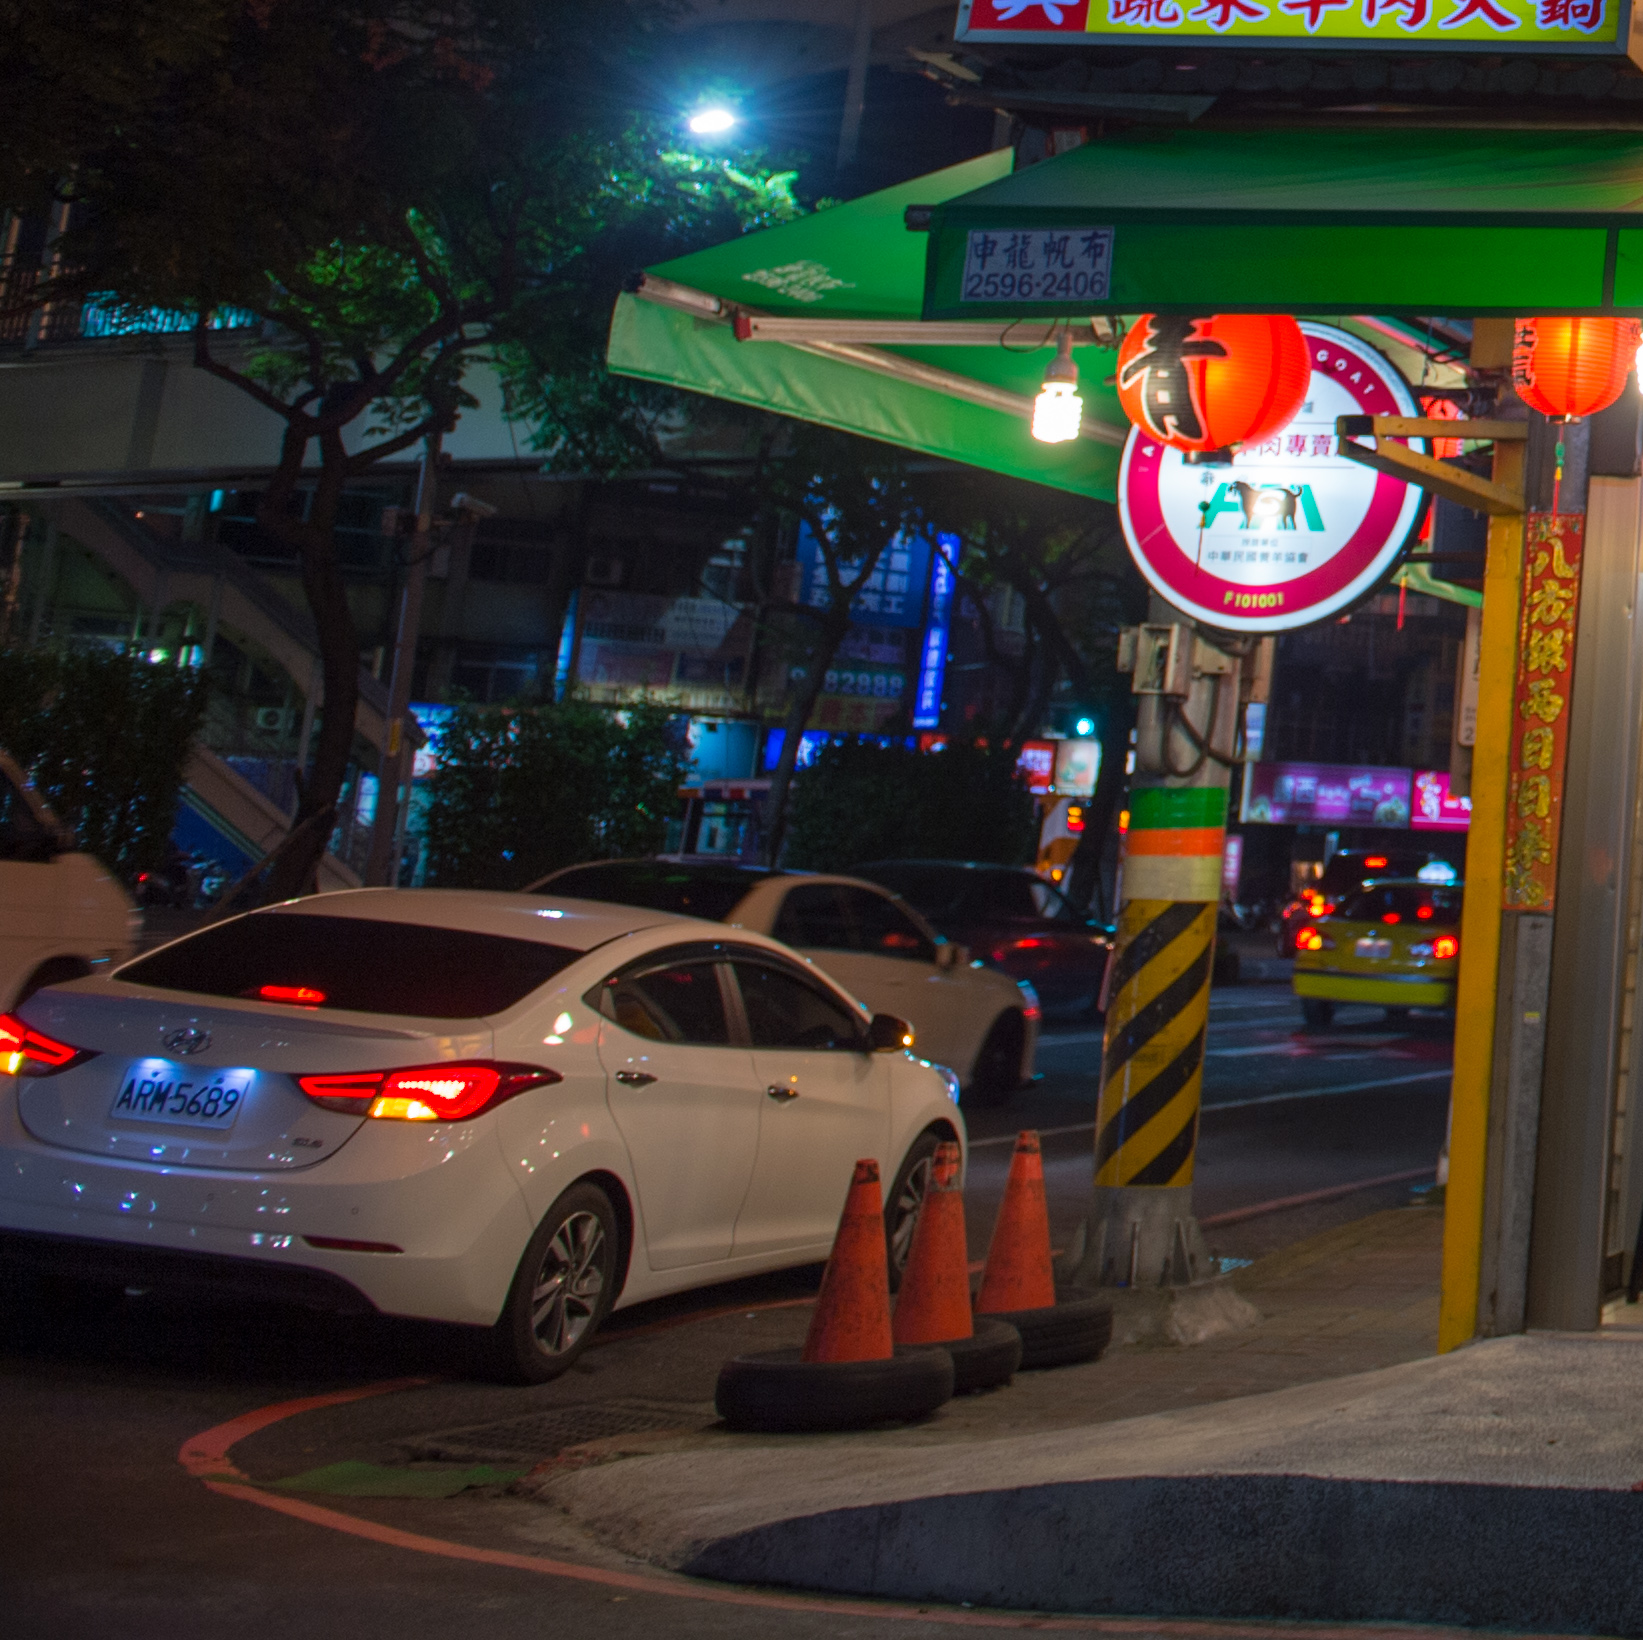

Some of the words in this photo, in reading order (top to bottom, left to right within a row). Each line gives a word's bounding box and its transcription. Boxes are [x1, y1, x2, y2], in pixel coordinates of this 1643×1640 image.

[972, 227, 1109, 271] 申龍帆布
[115, 1078, 240, 1119] ARM-5689
